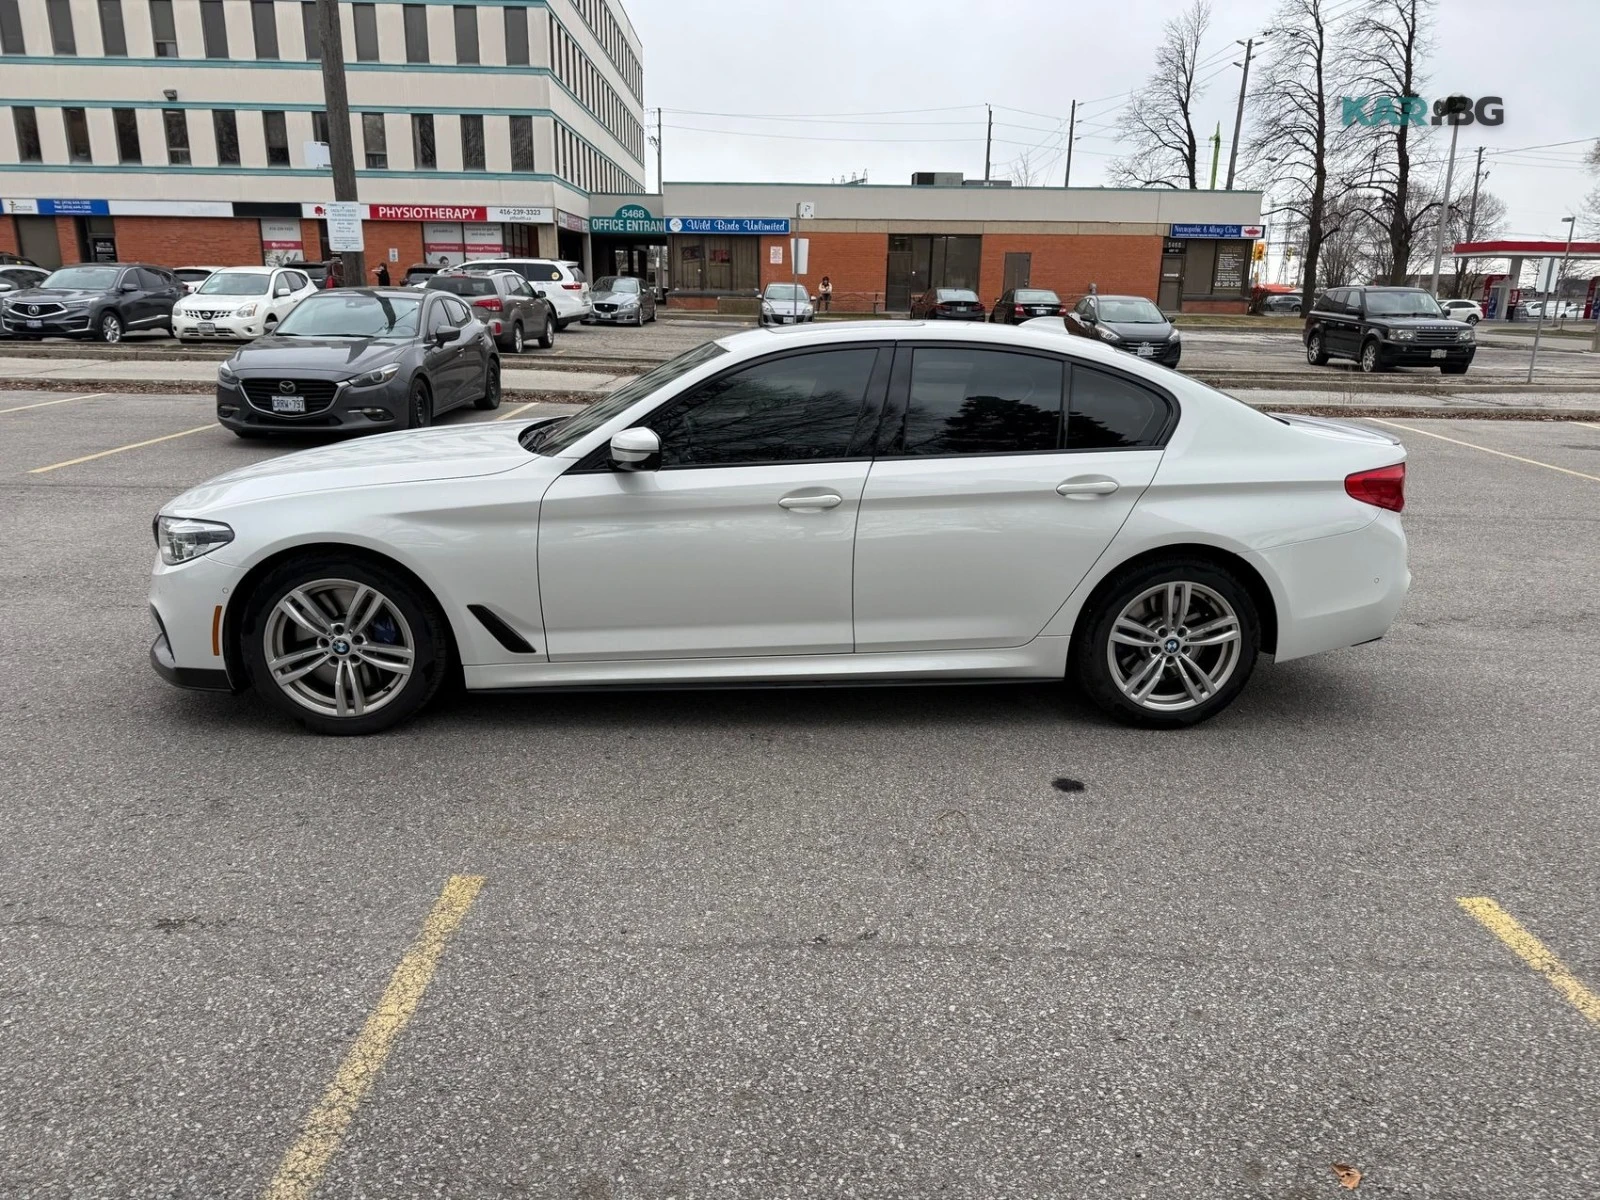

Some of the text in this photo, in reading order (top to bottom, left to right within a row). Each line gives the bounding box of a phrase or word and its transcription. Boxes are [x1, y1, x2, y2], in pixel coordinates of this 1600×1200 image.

[378, 206, 478, 220] PHYSIOTHERAPY
[499, 208, 541, 216] 416-239-3323
[621, 209, 645, 219] 5468
[592, 218, 625, 231] OFFICE
[626, 219, 663, 232] ENTRAN
[686, 219, 785, 232] Wild Birds Unlimited
[1225, 225, 1239, 234] Clinic
